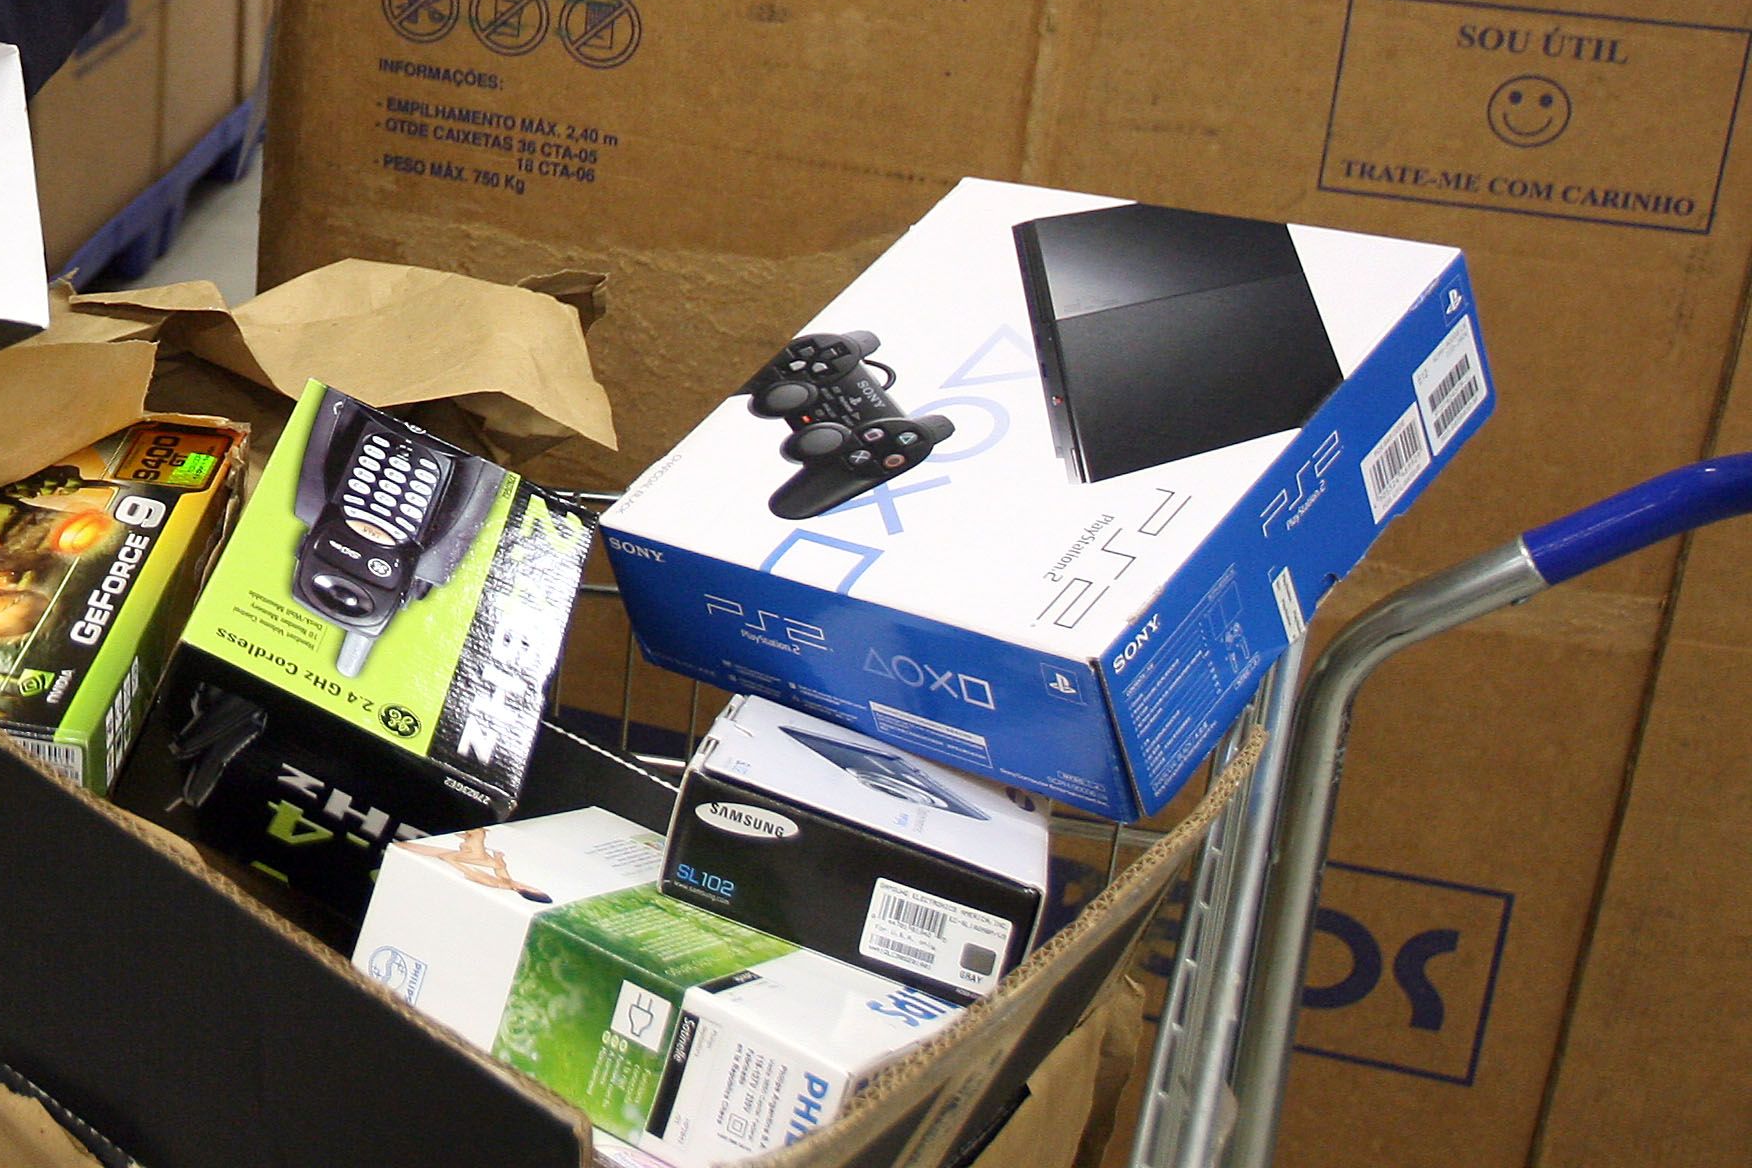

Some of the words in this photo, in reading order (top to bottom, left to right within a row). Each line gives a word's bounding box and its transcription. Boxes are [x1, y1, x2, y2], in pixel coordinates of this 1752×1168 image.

[1456, 23, 1532, 54] SOU
[1541, 26, 1629, 65] ÚTIL
[386, 96, 516, 131] EMPILHAMENTO
[433, 126, 514, 152] CAIXETAS
[540, 143, 598, 164] CTA-05
[382, 153, 426, 176] PESO
[473, 169, 499, 188] 750
[504, 175, 526, 195] Kg
[539, 161, 596, 182] CTA-06
[1340, 158, 1480, 193] TRATE-ME
[1488, 174, 1554, 201] COM
[1561, 186, 1696, 219] CARINHO
[856, 379, 887, 409] SONY
[132, 433, 180, 480] 9400
[115, 495, 167, 531] 9
[608, 536, 667, 564] SONY
[214, 624, 299, 677] Cordless
[1112, 613, 1162, 676] SONY
[301, 668, 343, 698] GHz
[346, 690, 375, 713] 2.4
[709, 801, 785, 839] SAMSUNG
[676, 863, 736, 898] SL102
[958, 970, 985, 985] GRAY
